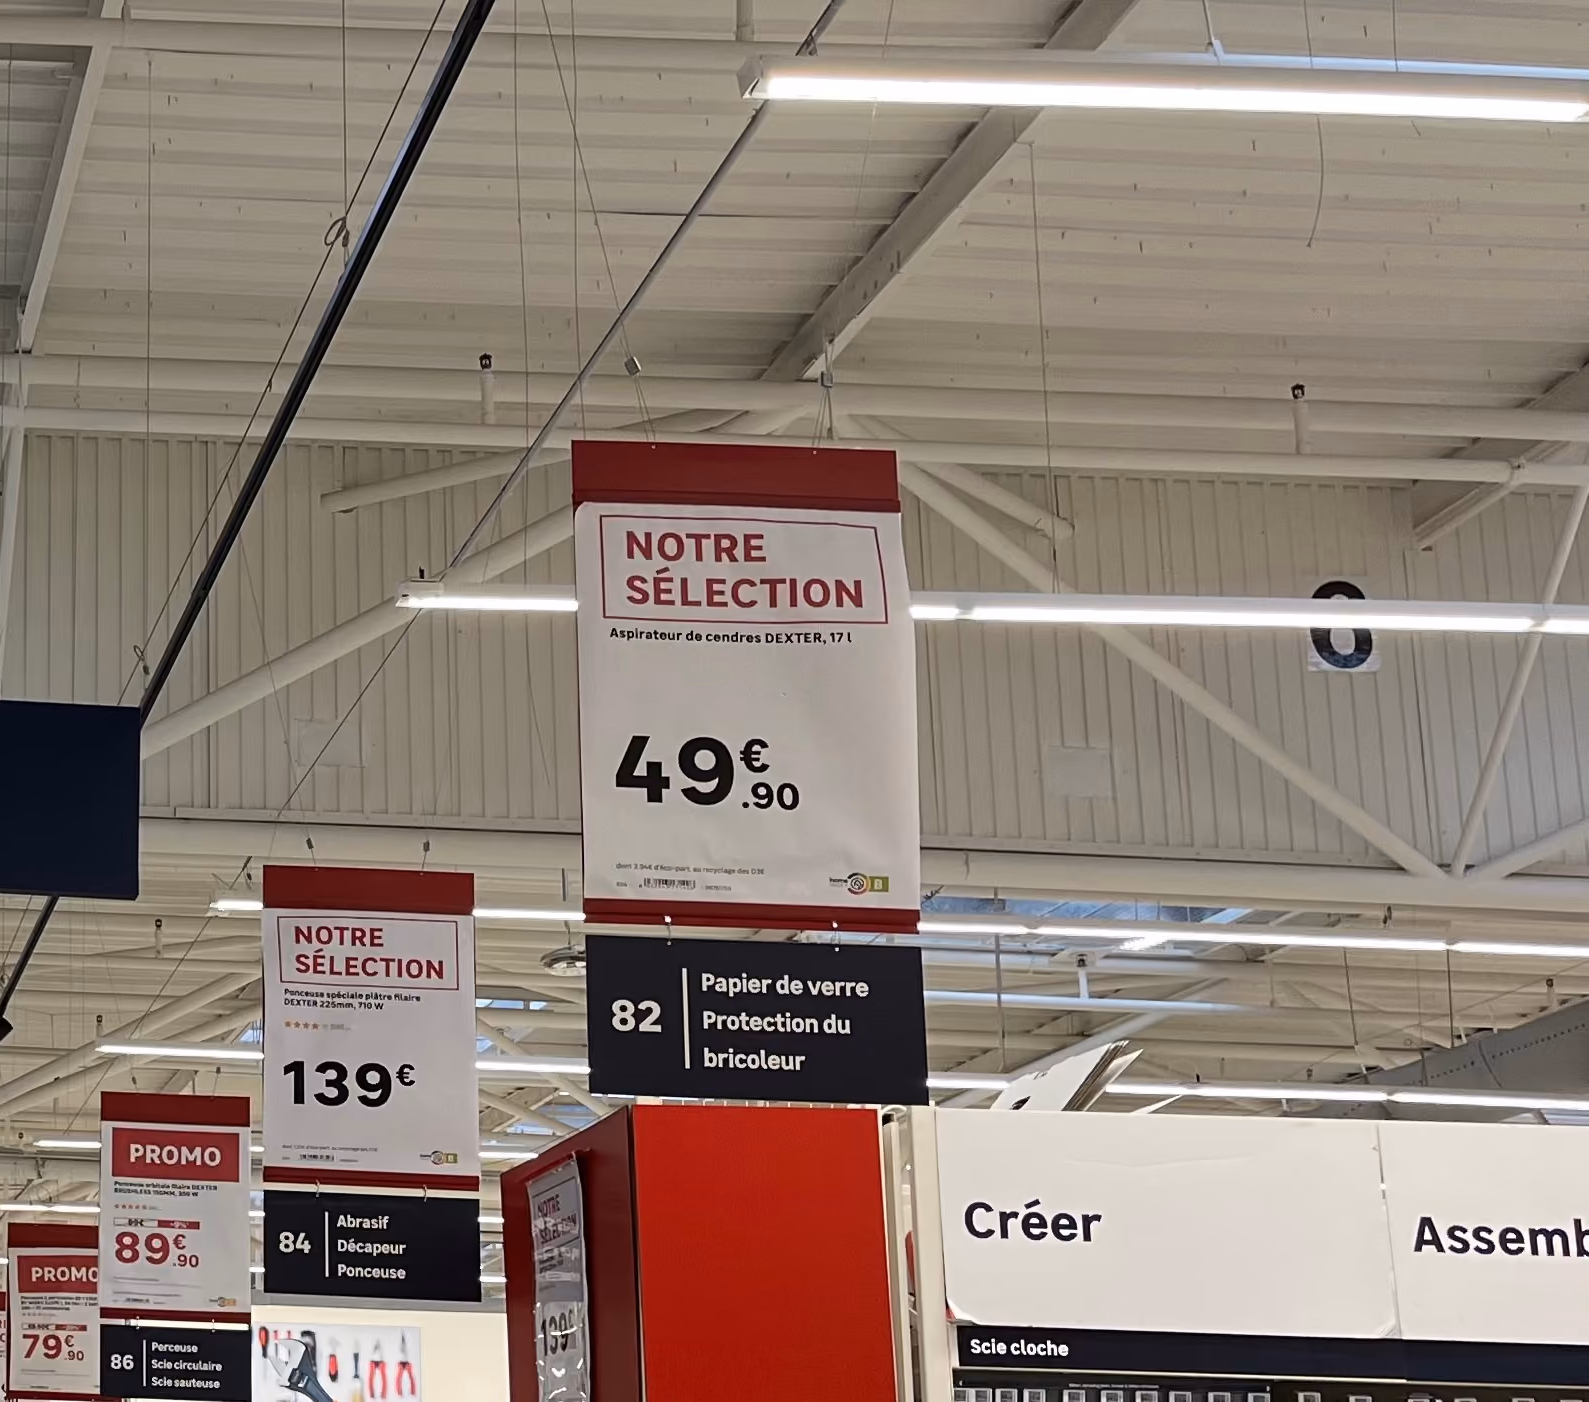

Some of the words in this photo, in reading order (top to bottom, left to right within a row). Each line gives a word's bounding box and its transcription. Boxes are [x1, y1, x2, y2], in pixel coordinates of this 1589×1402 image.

[625, 530, 767, 563] NOTRE
[625, 566, 864, 609] SÉLECTION
[609, 627, 683, 642] Aspirateur
[685, 630, 703, 643] de
[705, 631, 762, 644] cendres
[765, 631, 827, 645] DEXTER,
[829, 632, 844, 644] 17
[294, 925, 384, 947] NOTRE
[295, 948, 444, 980] SÉLECTION
[701, 973, 772, 997] Papier
[776, 975, 803, 995] de
[806, 979, 869, 997] verre
[284, 988, 325, 999] Ponceuse
[326, 990, 364, 1001] spéciale
[365, 991, 392, 1002] plâtre
[394, 993, 421, 1003] filaire
[284, 998, 318, 1008] DEXTER
[358, 1001, 373, 1010] 710
[374, 1001, 384, 1010] W
[611, 999, 662, 1033] 82
[703, 1010, 818, 1033] Protection
[823, 1014, 851, 1034] du
[703, 1047, 806, 1071] bricoleur
[129, 1143, 221, 1167] PROMO
[337, 1215, 390, 1230] Abrasif
[964, 1198, 1102, 1243] Créer
[279, 1231, 311, 1254] 84
[338, 1238, 407, 1256] Décapeur
[338, 1264, 407, 1280] Ponceuse
[151, 1341, 198, 1353] Perceuse
[970, 1338, 1007, 1355] Scie
[1010, 1339, 1069, 1357] cloche
[110, 1354, 134, 1370] 86
[151, 1359, 172, 1369] Scie
[174, 1360, 222, 1372] circulaire
[151, 1376, 172, 1387] Scie
[174, 1378, 220, 1389] sauteuse
